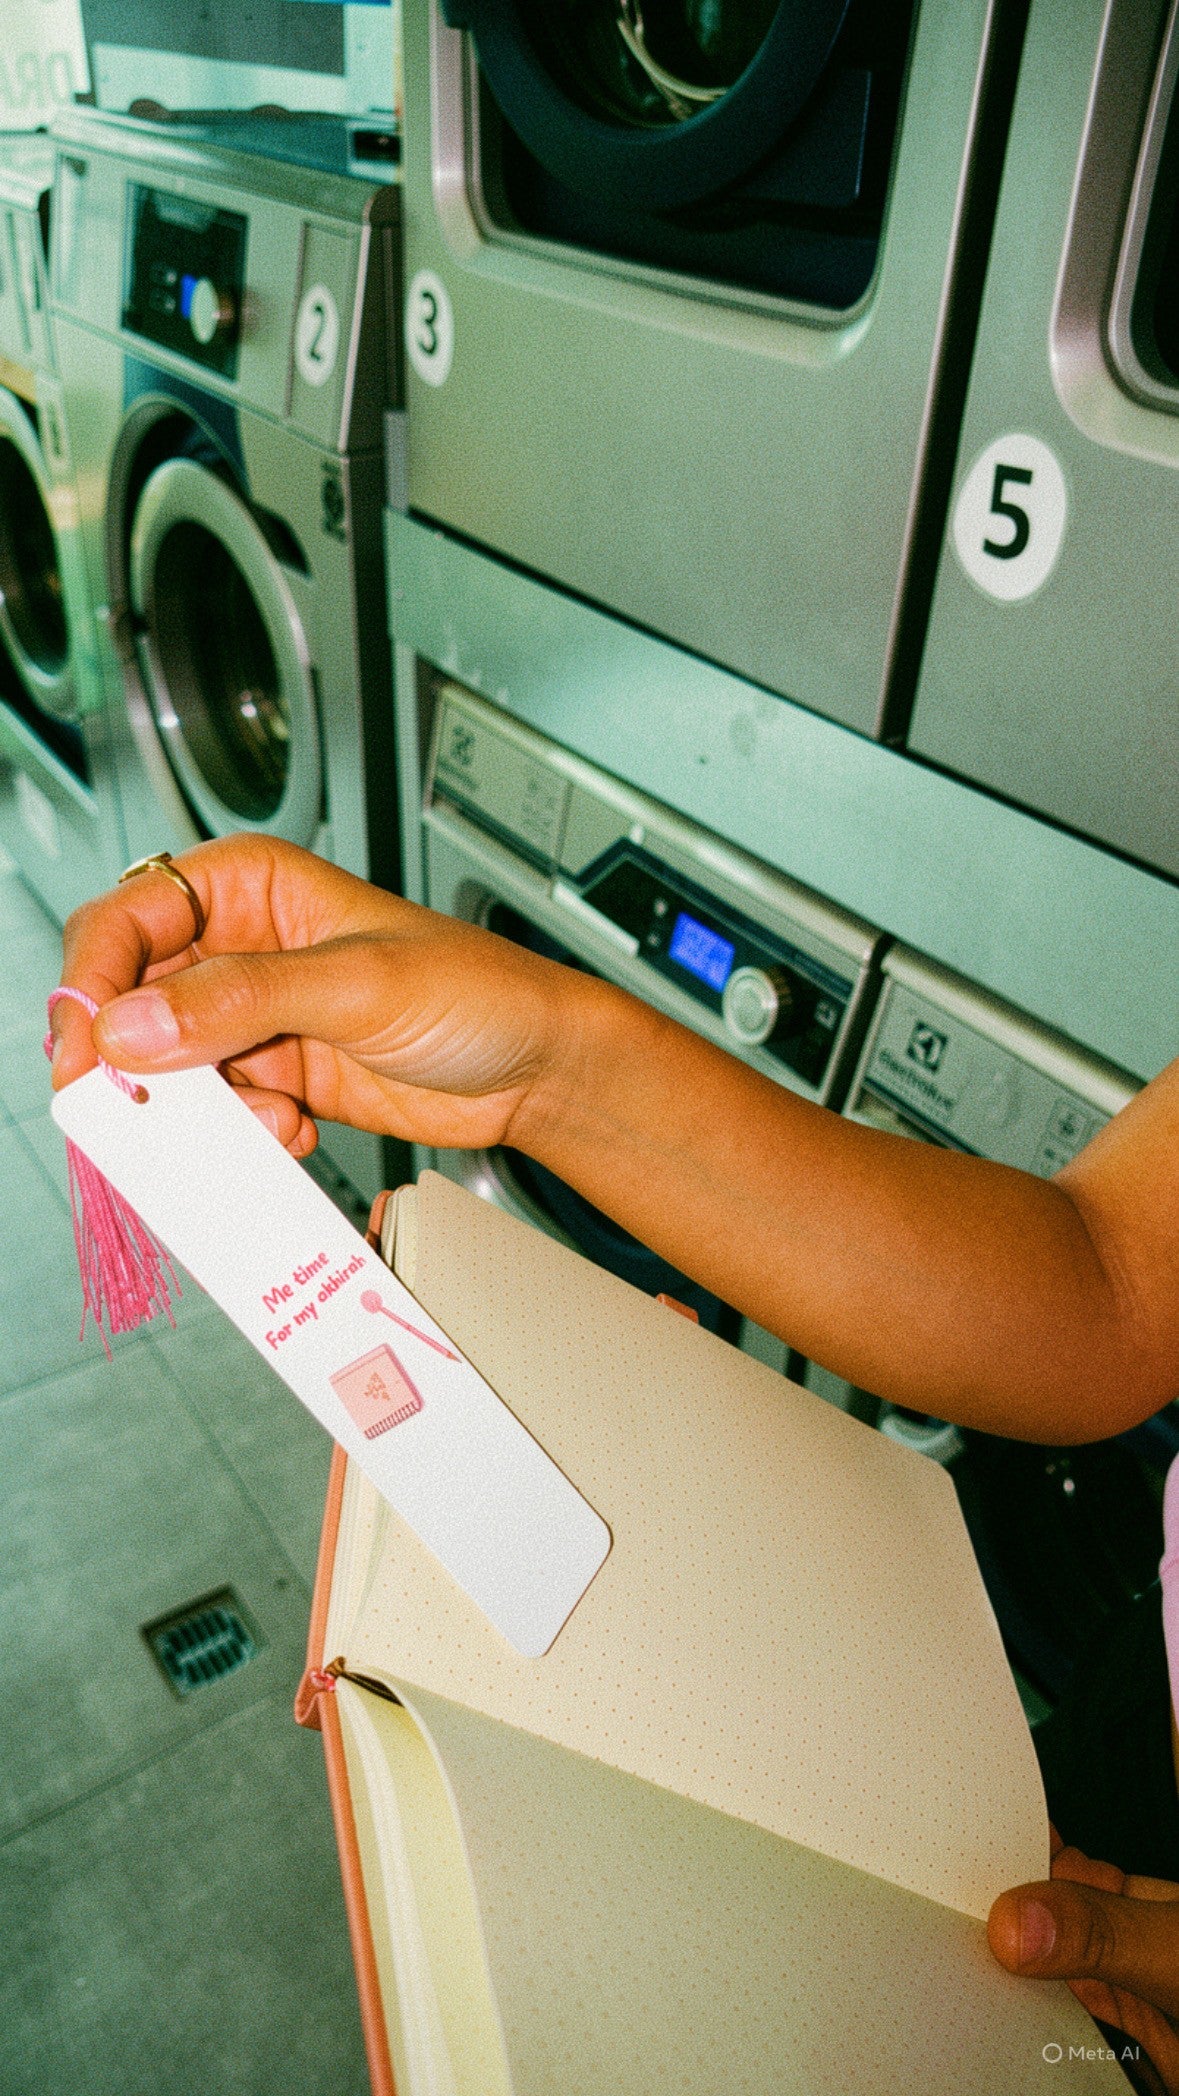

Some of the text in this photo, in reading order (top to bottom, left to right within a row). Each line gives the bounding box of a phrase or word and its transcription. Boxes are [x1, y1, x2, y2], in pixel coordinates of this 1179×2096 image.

[308, 303, 326, 363] 2
[415, 290, 439, 357] 3
[982, 463, 1034, 561] 5
[262, 1253, 329, 1314] Me time
[266, 1255, 366, 1350] For my akhirah
